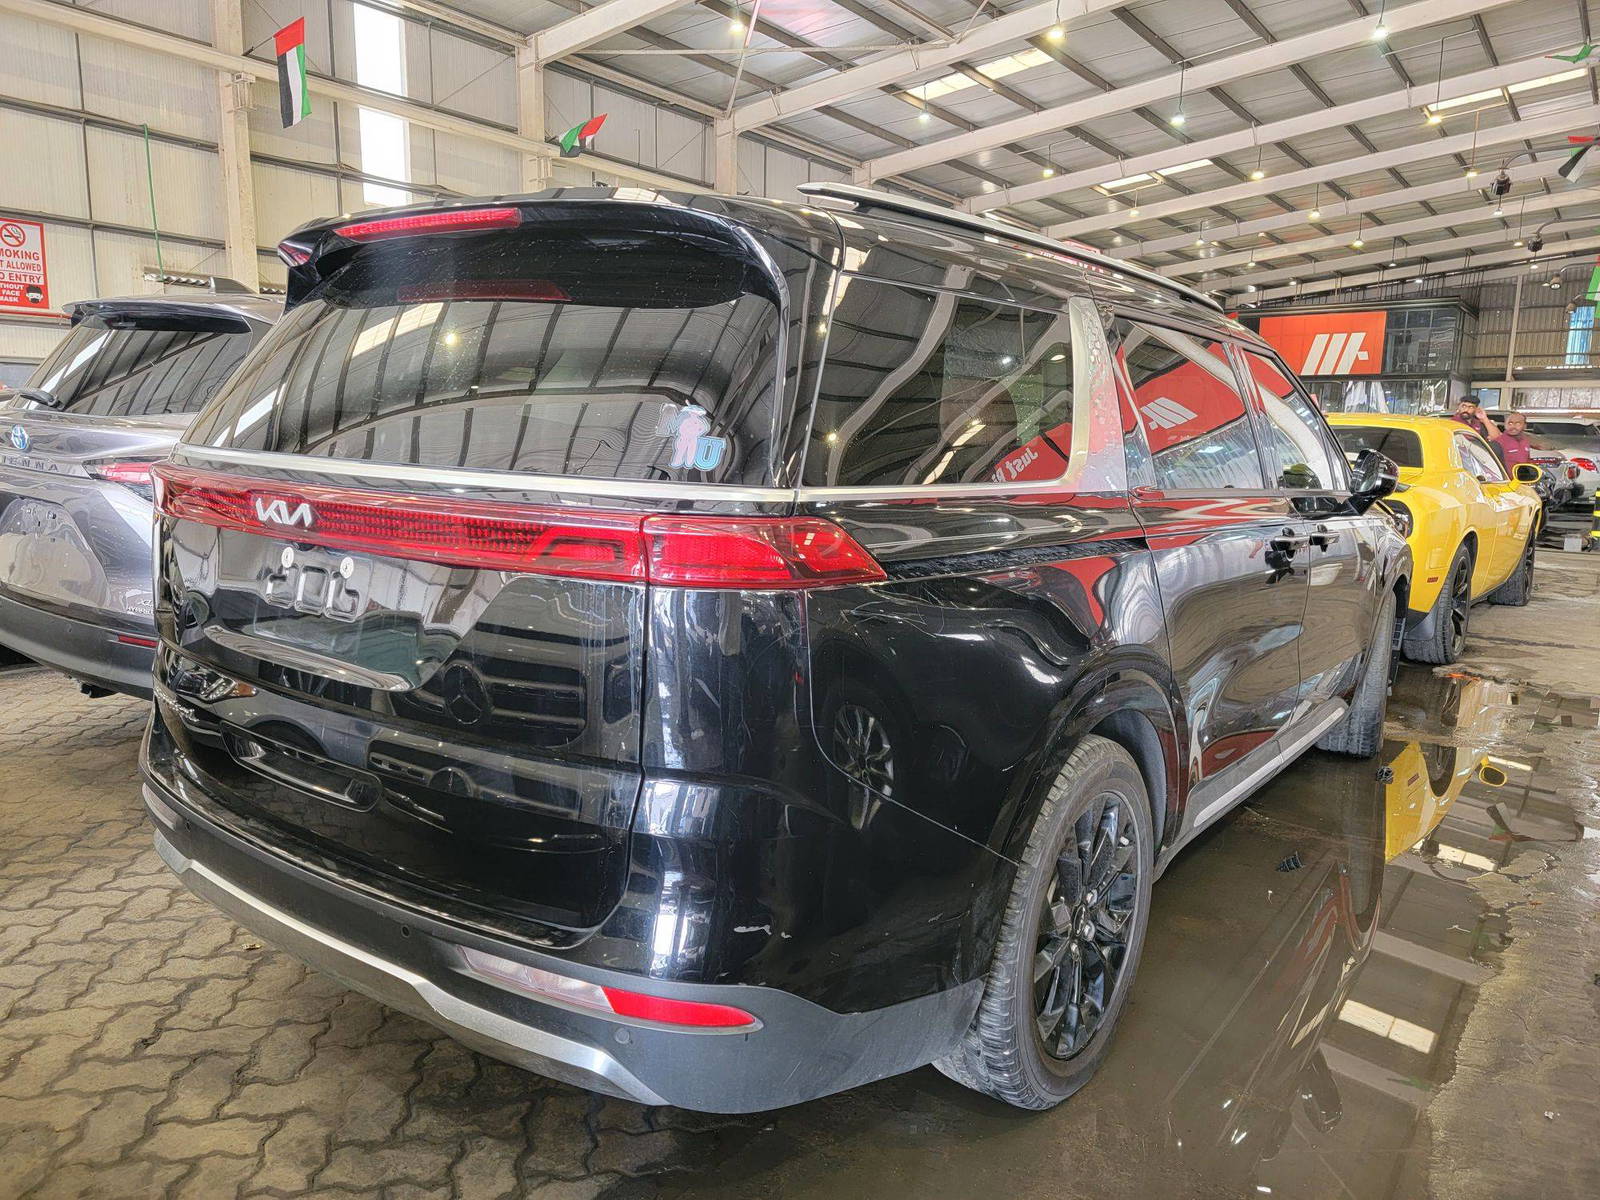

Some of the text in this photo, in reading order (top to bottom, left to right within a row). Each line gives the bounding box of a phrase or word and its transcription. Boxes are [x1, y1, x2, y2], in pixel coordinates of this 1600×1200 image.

[7, 261, 41, 271] ALLOWED
[9, 273, 41, 283] ENTRY
[256, 497, 312, 527] KIA
